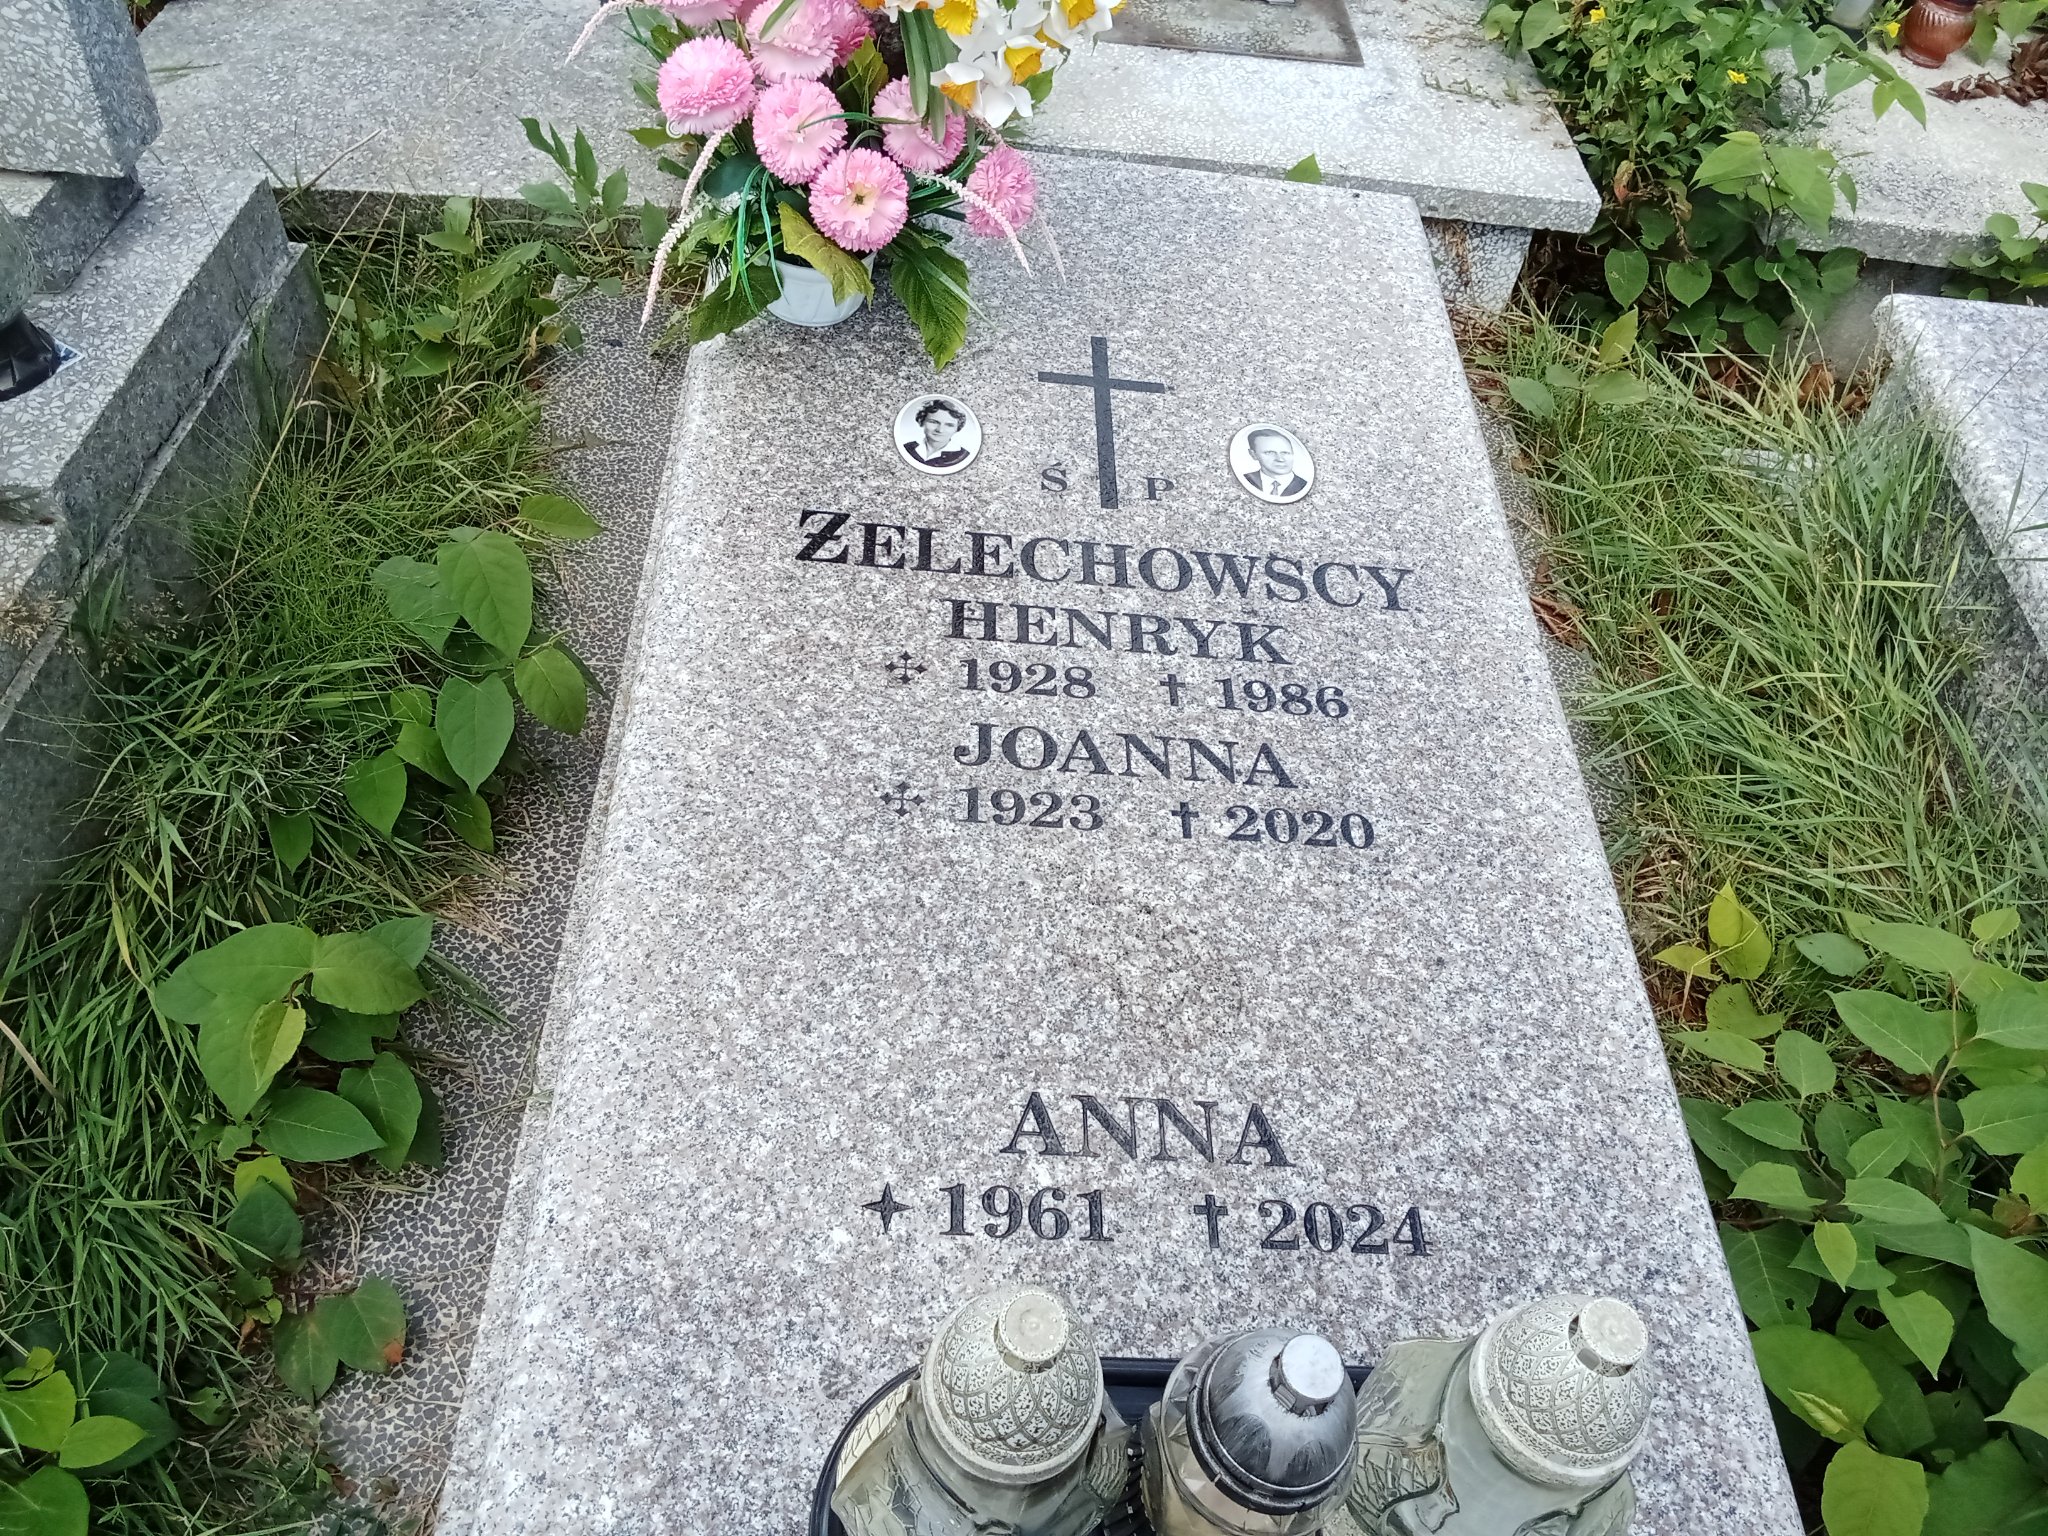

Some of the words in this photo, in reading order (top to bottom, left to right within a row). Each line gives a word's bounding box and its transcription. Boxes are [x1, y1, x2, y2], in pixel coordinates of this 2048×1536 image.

[1040, 461, 1068, 494] Ś
[1147, 476, 1175, 501] P
[944, 599, 1292, 665] HENRYK
[963, 658, 1096, 699] 1928
[1215, 678, 1350, 719] 1986
[954, 722, 1298, 789] JOANNA
[962, 787, 1104, 832] 1923
[1226, 806, 1376, 850] 2020
[1000, 1091, 1292, 1168] ANNA
[938, 1182, 1113, 1242] 1961
[1258, 1199, 1432, 1257] 2024
